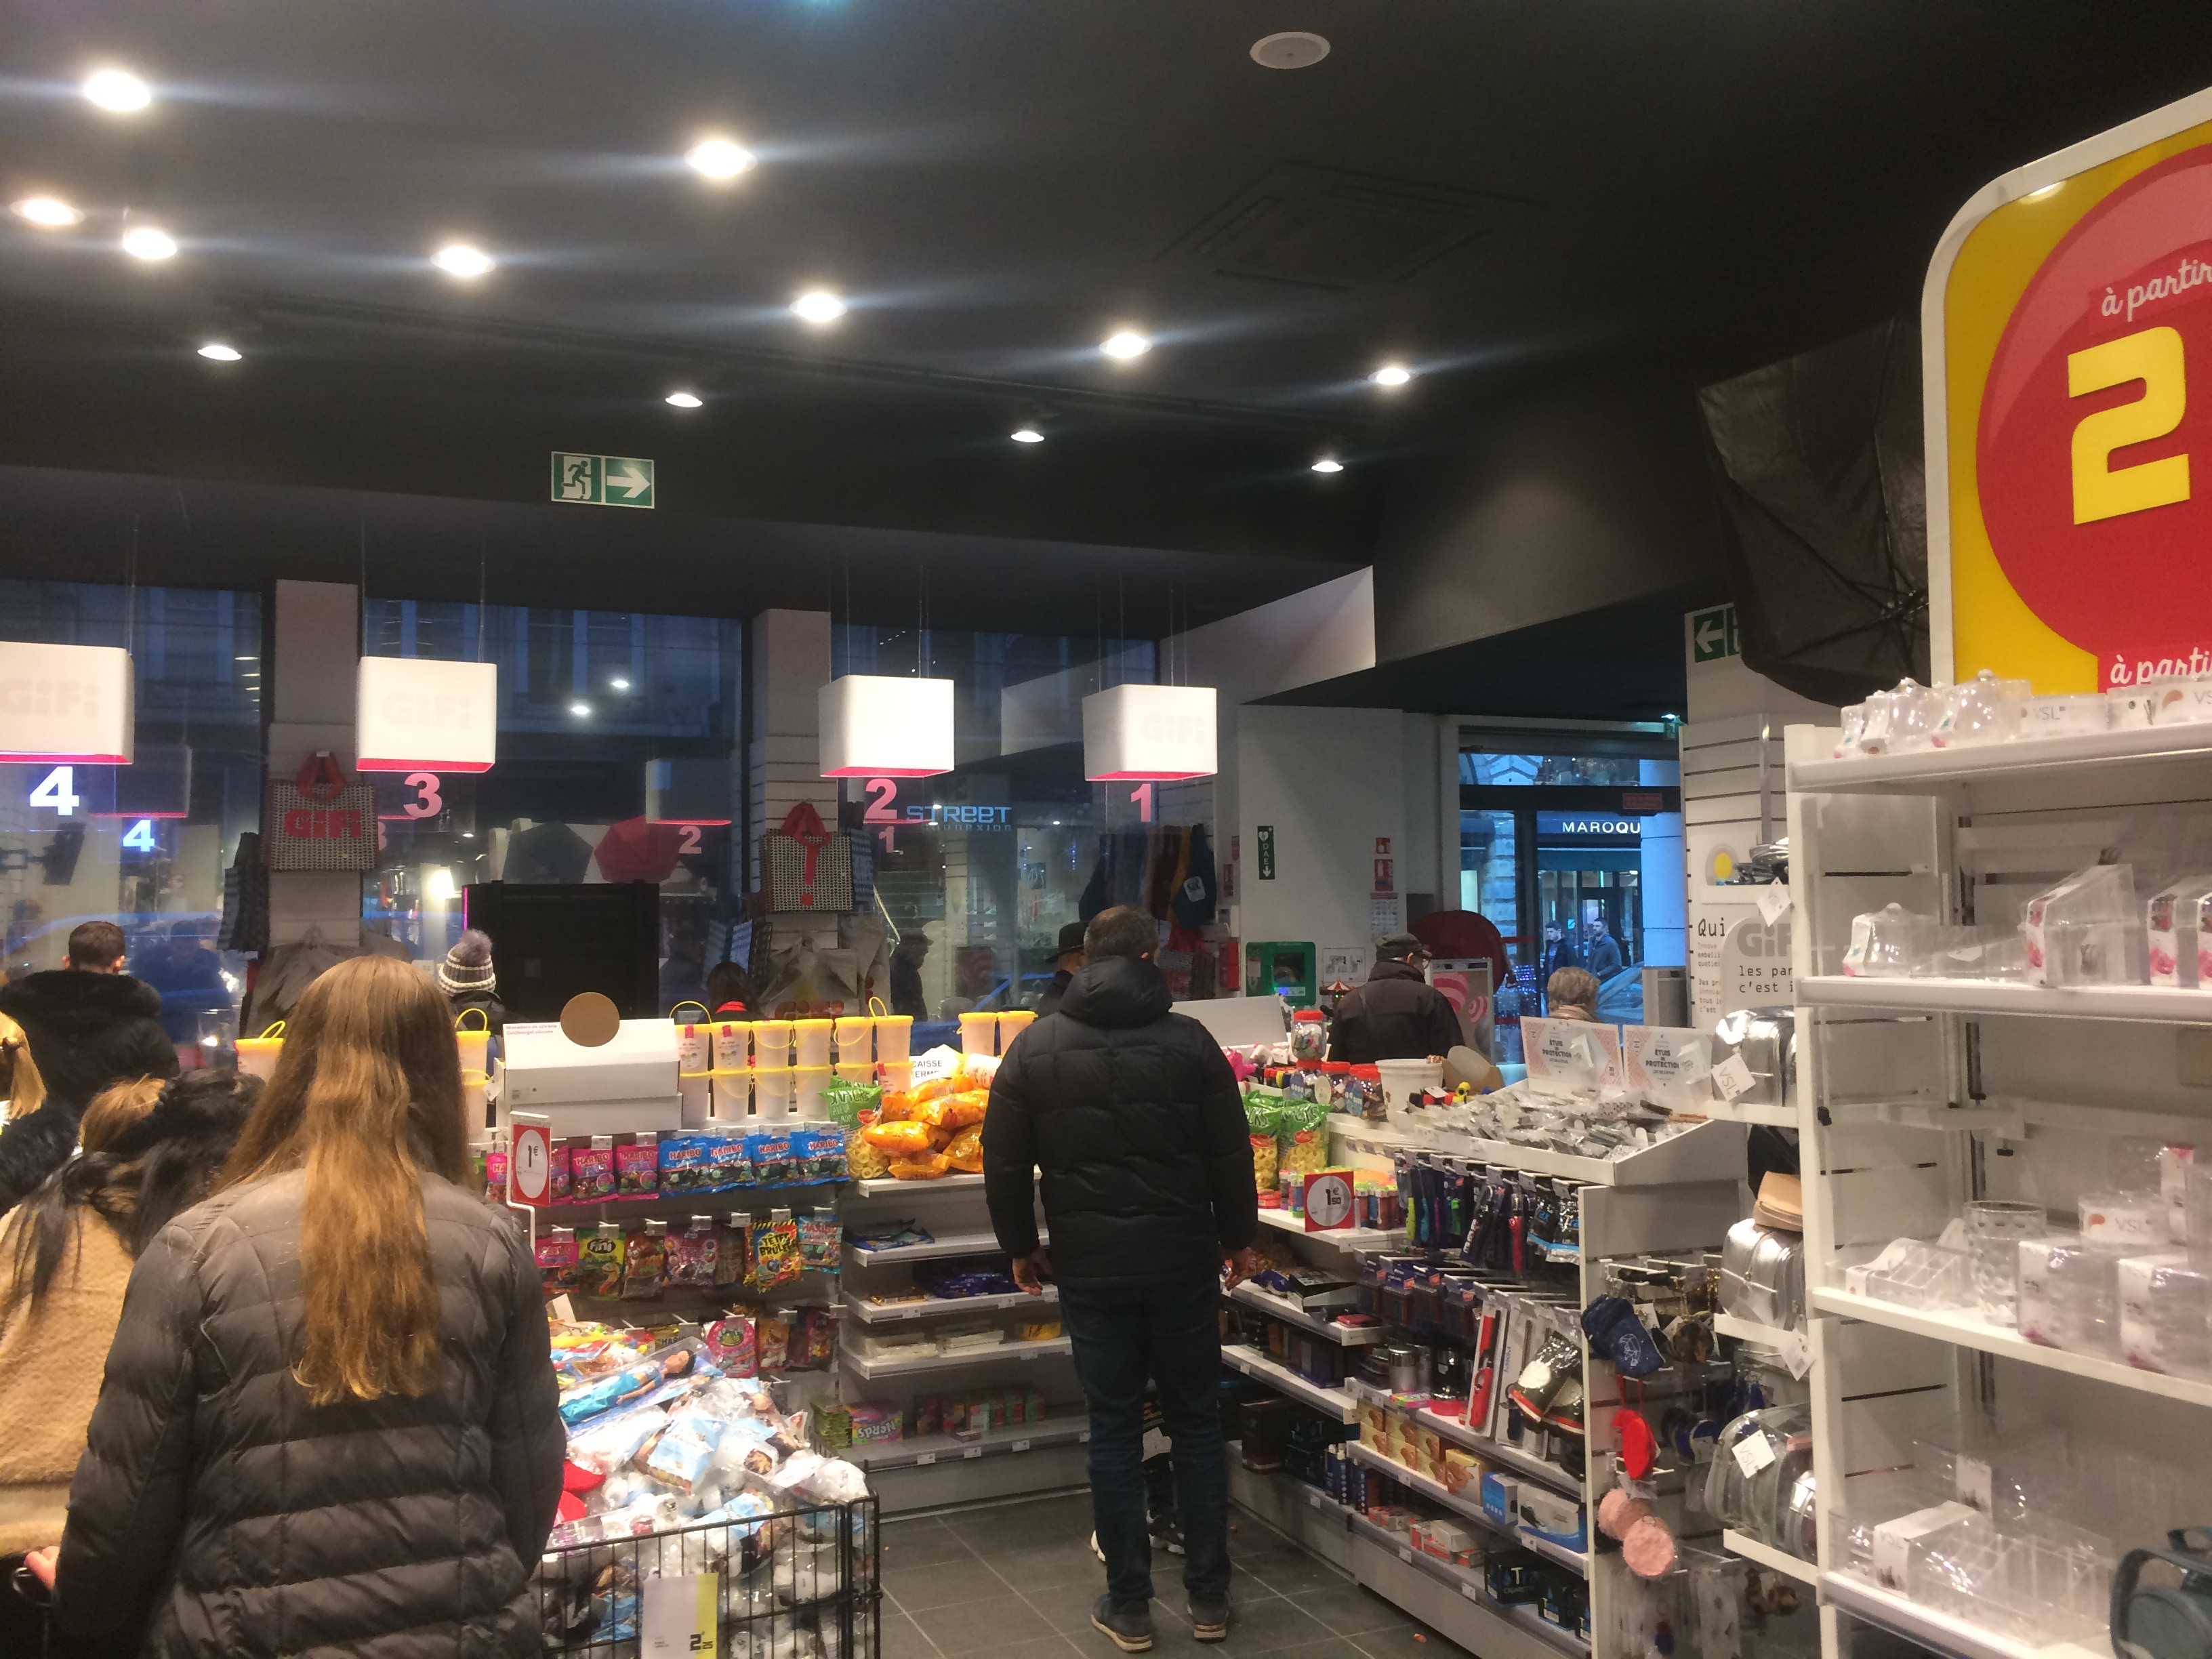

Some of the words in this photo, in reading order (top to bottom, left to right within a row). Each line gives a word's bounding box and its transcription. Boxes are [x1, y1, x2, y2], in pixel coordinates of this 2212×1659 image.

[2102, 287, 2123, 316] à
[2127, 258, 2212, 322] partir
[2068, 326, 2191, 525] 2
[2110, 654, 2132, 684] à
[2137, 647, 2212, 685] parti
[29, 766, 80, 816] 4
[403, 773, 443, 818] 3
[865, 778, 898, 819] 2
[1130, 783, 1151, 823] 1
[122, 819, 155, 853] 4
[678, 825, 702, 854] 2
[878, 825, 895, 853] 1
[1562, 821, 1641, 834] MAROQU
[1698, 917, 1725, 937] Qui
[1740, 965, 1762, 977] les
[1739, 981, 1778, 993] c'est
[912, 1060, 943, 1068] CAISSE
[1719, 1067, 1737, 1096] VSL
[623, 1151, 655, 1160] HARIBO
[669, 1147, 702, 1161] HARIBO
[758, 1141, 790, 1154] HARIBO
[808, 1138, 840, 1151] HARIBO
[575, 1152, 610, 1166] HARIBO
